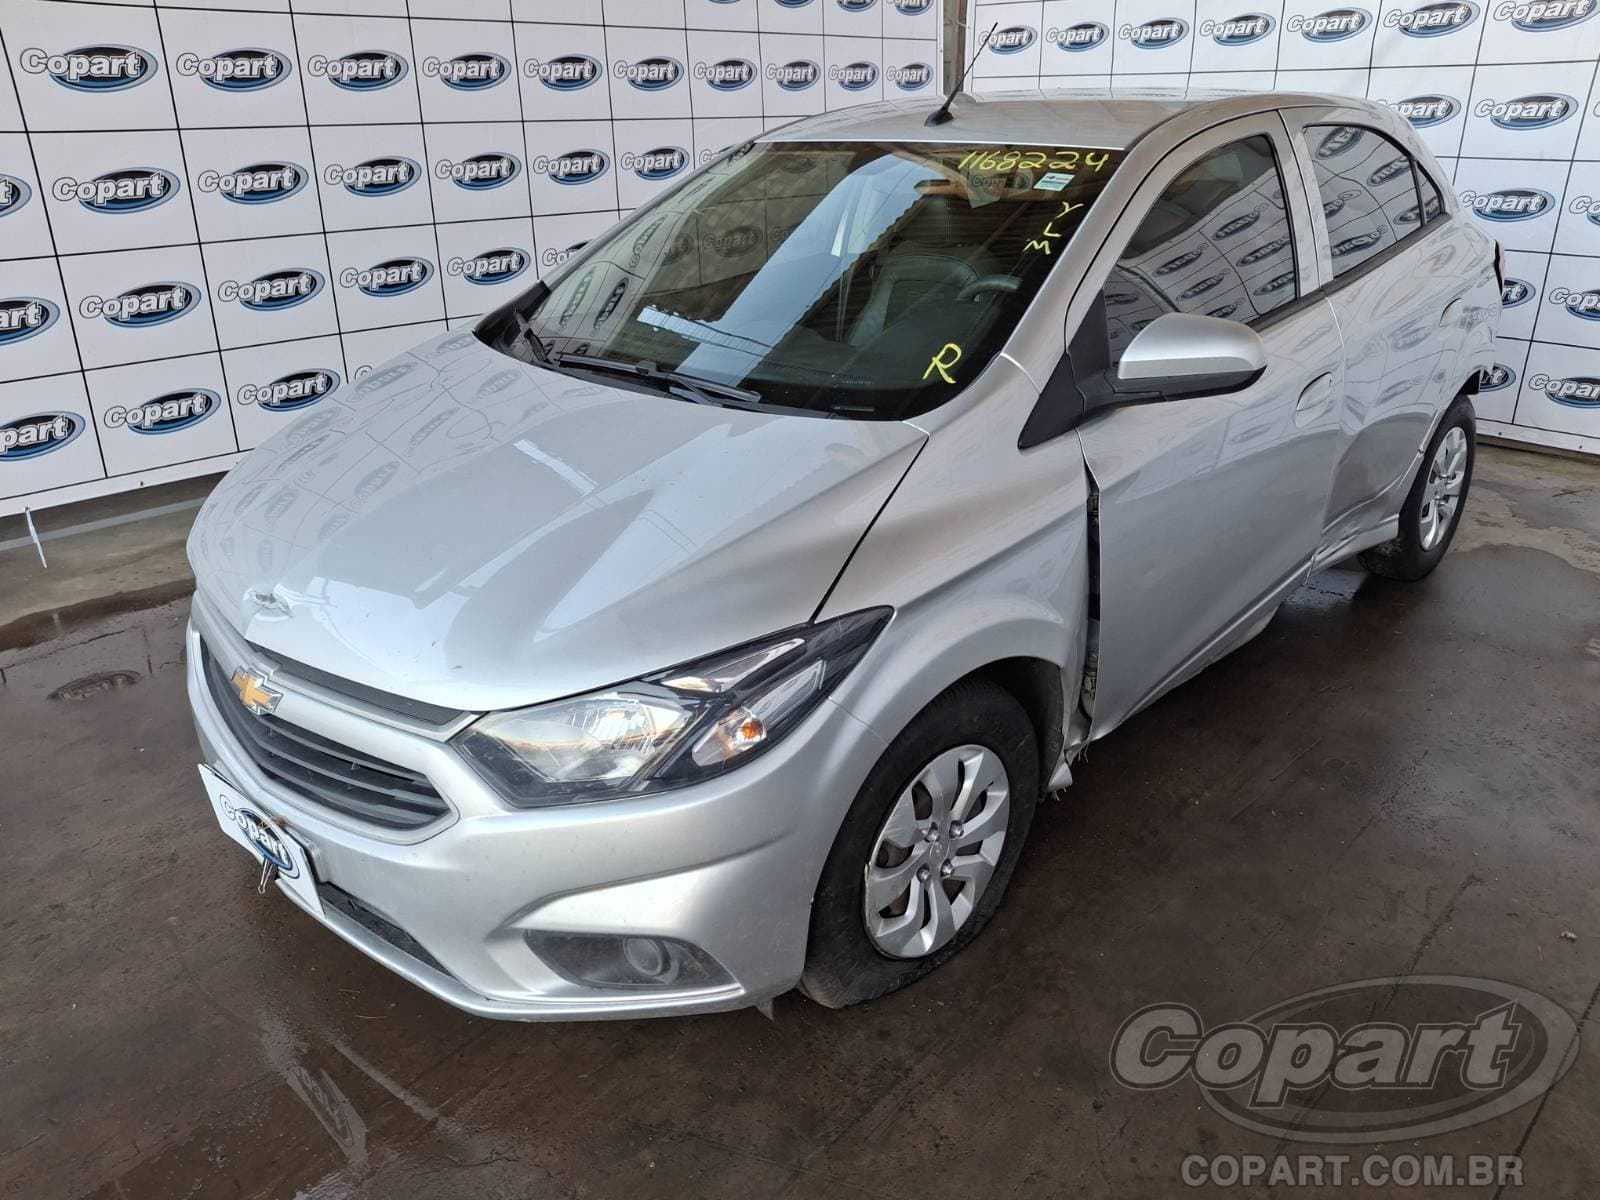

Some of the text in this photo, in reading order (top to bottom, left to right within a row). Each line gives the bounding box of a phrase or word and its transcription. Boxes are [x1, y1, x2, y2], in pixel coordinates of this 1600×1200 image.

[1287, 11, 1362, 34] Copart
[1383, 5, 1470, 31] Copart
[1493, 0, 1591, 25] Copart
[978, 29, 1029, 49] Copart
[1046, 22, 1101, 49] Copart
[1118, 18, 1181, 46] Copart
[1200, 14, 1267, 43] Copart
[20, 48, 141, 82] Copart
[176, 53, 279, 82] Copart
[308, 55, 397, 80] Copart
[423, 56, 500, 80] Copart
[524, 58, 593, 81] Copart
[613, 59, 677, 82] Copart
[694, 61, 750, 84] Copart
[766, 63, 814, 85] Copart
[828, 64, 875, 85] Copart
[886, 65, 929, 87] Copart
[1474, 98, 1567, 121] Copart
[435, 157, 513, 183] Copart
[533, 154, 602, 178] Copart
[620, 149, 682, 173] Copart
[957, 150, 1110, 172] 1168224
[52, 171, 165, 204] Copart
[198, 165, 296, 197] Copart
[324, 160, 411, 190] Copart
[1459, 190, 1545, 212] Copart
[340, 261, 423, 290] Copart
[447, 251, 522, 278] Copart
[217, 272, 312, 304] Copart
[79, 285, 187, 320] Copart
[922, 343, 962, 384] R
[237, 371, 329, 406] Copart
[104, 391, 208, 429] Copart
[0, 415, 69, 455] part
[219, 794, 290, 866] Copart
